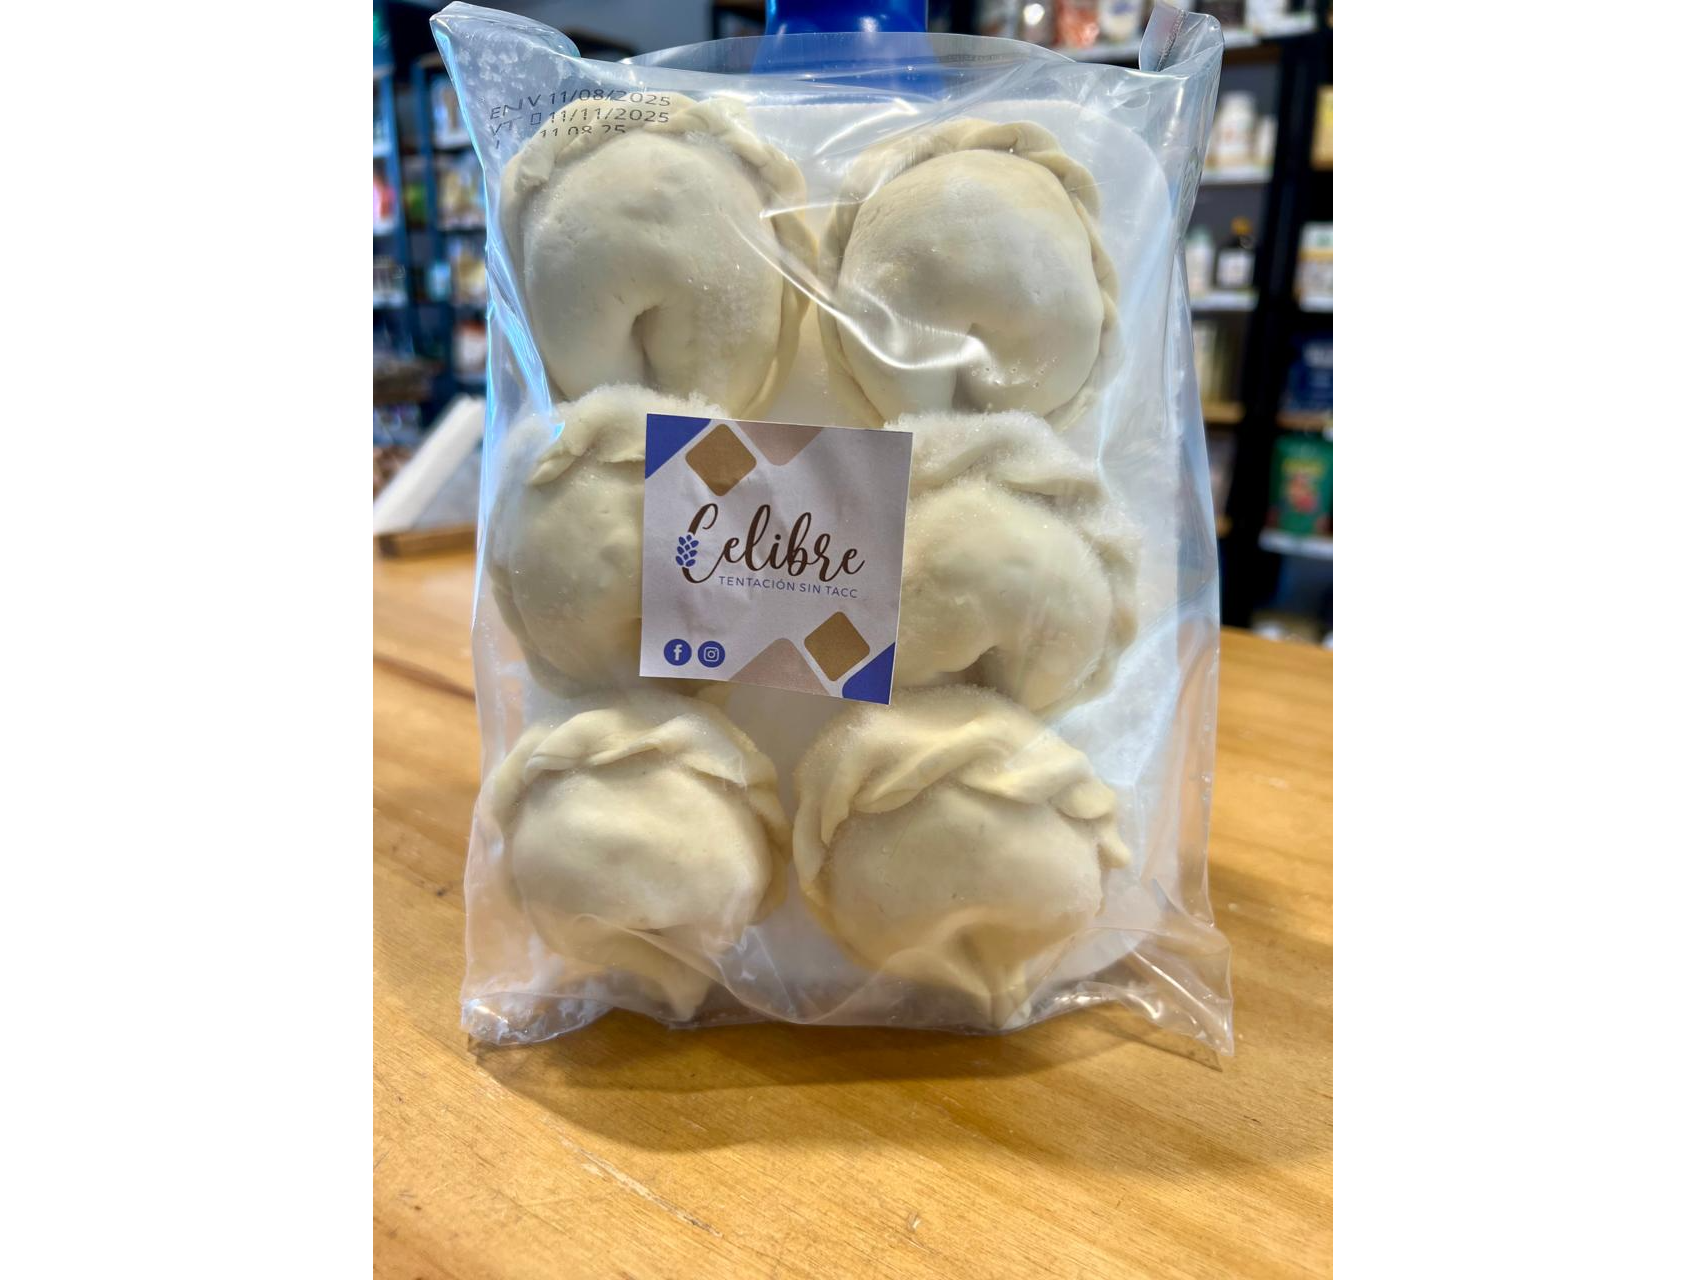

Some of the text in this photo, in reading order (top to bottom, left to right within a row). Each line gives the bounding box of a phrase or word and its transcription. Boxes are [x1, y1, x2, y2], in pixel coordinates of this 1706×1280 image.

[490, 89, 671, 120] ENV 11/08/2025
[549, 107, 670, 124] 11/11/2025
[675, 502, 865, 584] Celibre
[718, 575, 859, 599] TENTACIÓN SIN TACC
